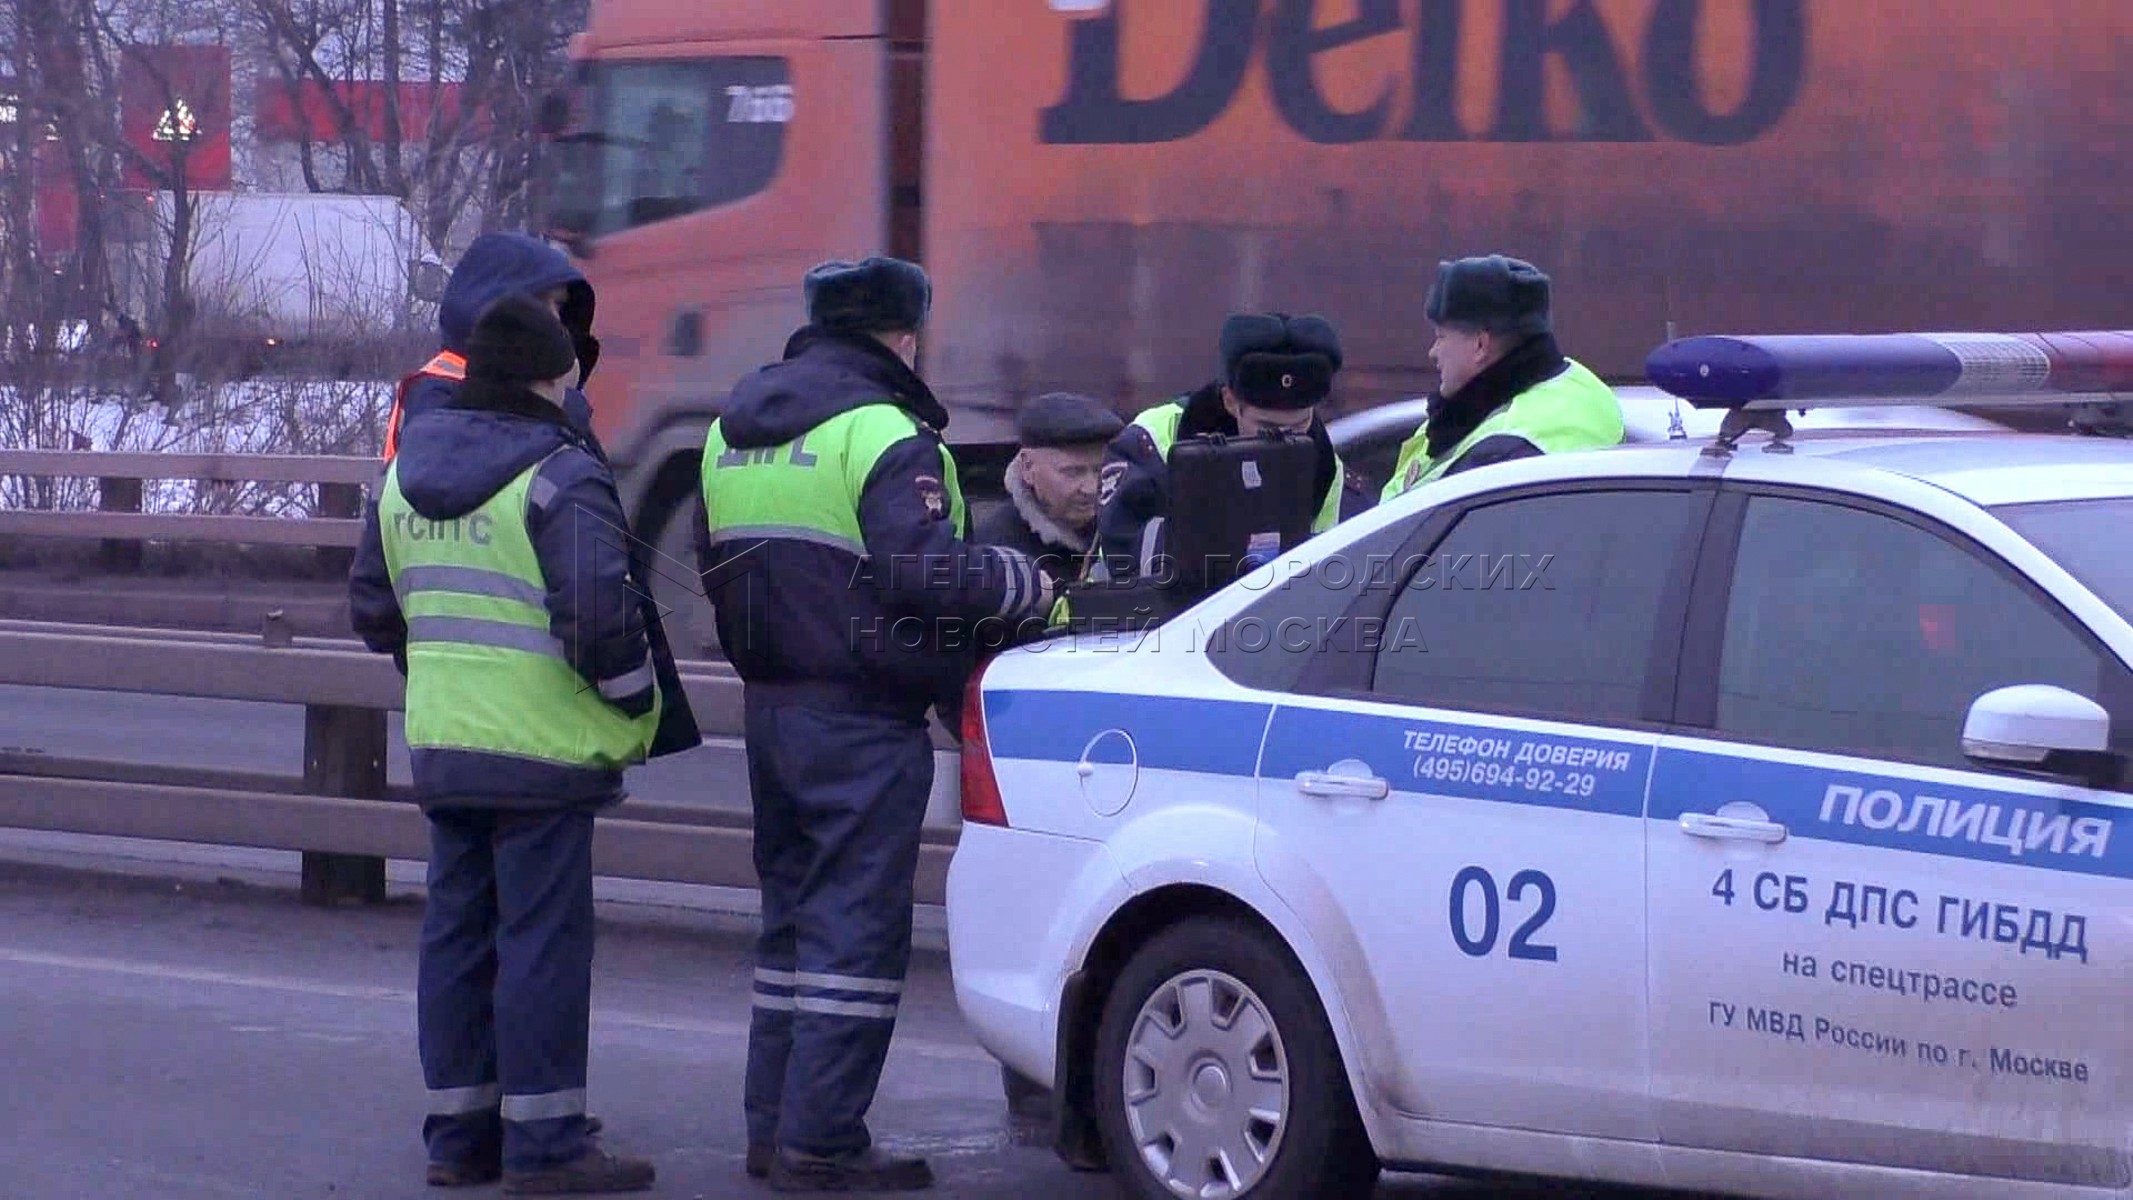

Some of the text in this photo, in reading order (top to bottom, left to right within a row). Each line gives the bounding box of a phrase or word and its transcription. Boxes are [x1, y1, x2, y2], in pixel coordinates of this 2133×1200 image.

[1403, 730, 1631, 772] ТЕЛЕФОН ДОВЕРИЯ
[1413, 755, 1596, 797] (495)694-92-29
[1818, 784, 2114, 858] ПОЛИЦИЯ
[1450, 865, 1558, 962] 02
[1712, 869, 2088, 963] 4 СБ ДПС ГИБДД
[1782, 951, 2018, 1008] на спецтрассе
[1708, 1001, 1736, 1027] ГУ
[1747, 1007, 1805, 1042] МВД
[1815, 1018, 1906, 1057] России
[1918, 1041, 1947, 1063] по
[1990, 1048, 2089, 1083] Москве
